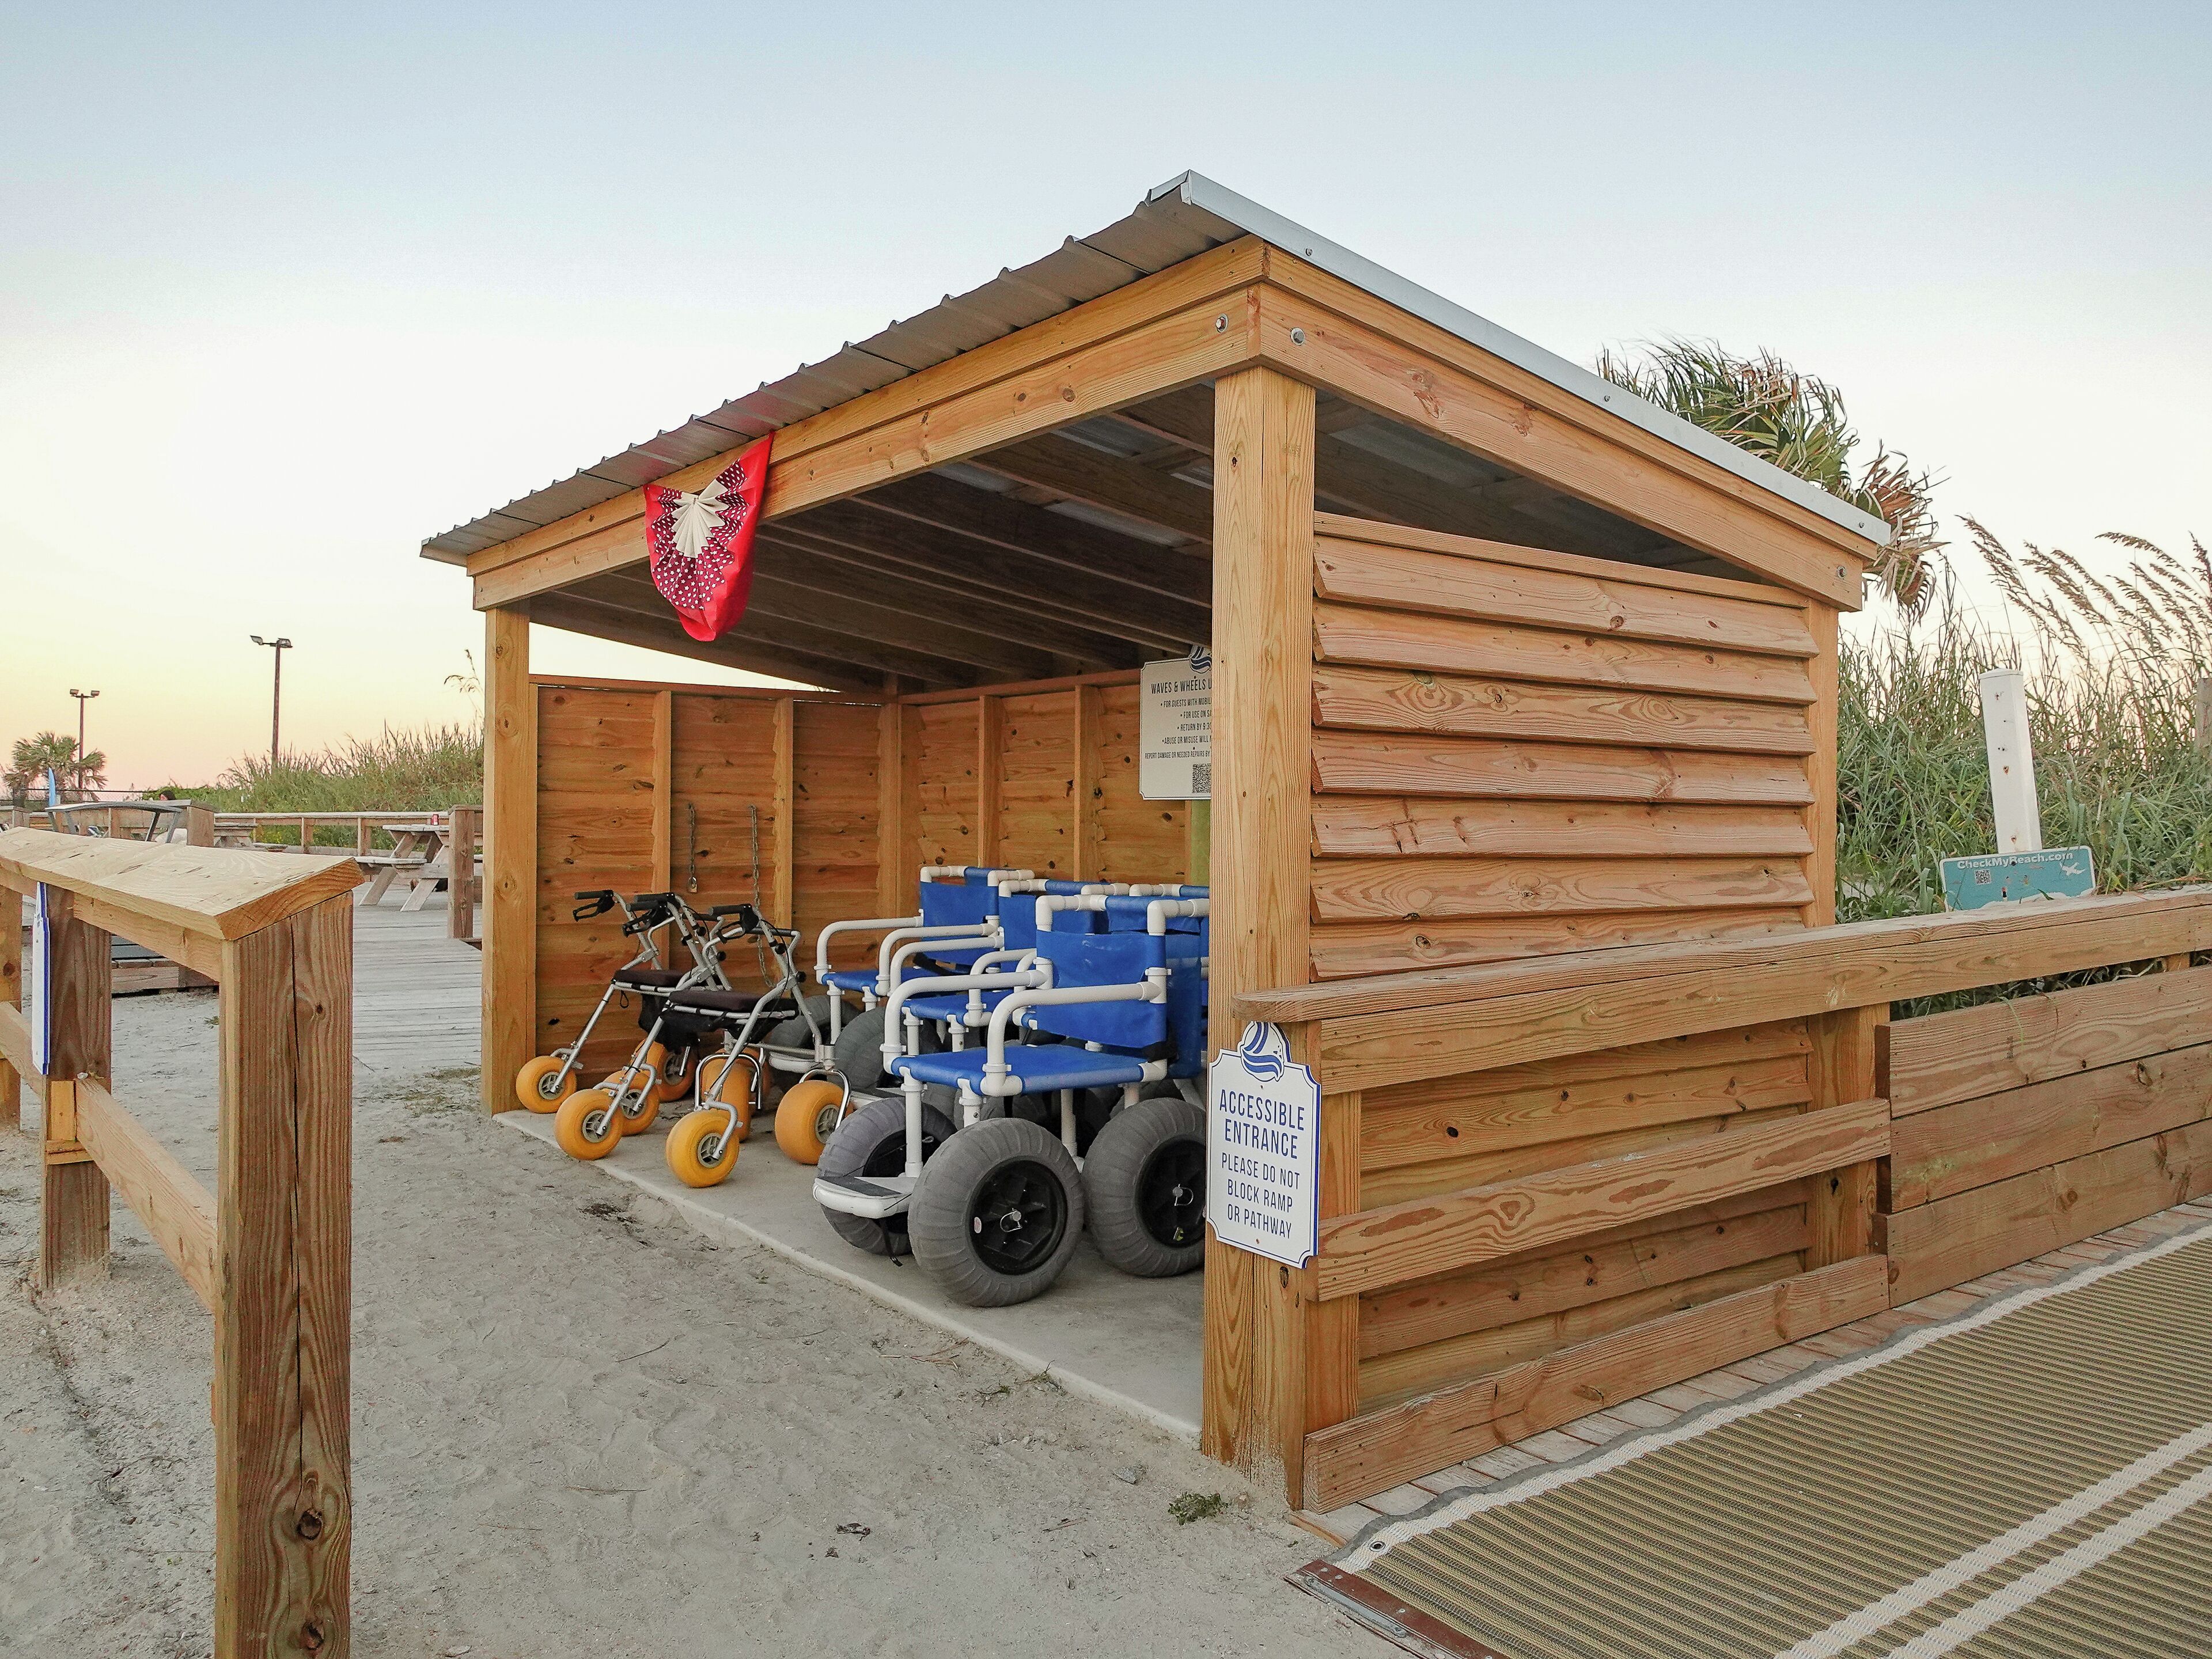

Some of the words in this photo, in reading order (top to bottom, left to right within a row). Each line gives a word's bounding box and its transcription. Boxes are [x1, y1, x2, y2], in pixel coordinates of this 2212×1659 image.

[1152, 682, 1172, 694] WAVES
[1174, 681, 1178, 692] &
[1180, 679, 1206, 692] WHEELS
[1172, 699, 1187, 707] GUESTS
[1187, 698, 1197, 706] WITH
[1200, 710, 1206, 718] ON
[1180, 724, 1196, 732] RETURN
[1196, 723, 1202, 731] BY
[1164, 736, 1176, 744] ABUSE
[1184, 736, 1198, 744] MISUSE
[1199, 735, 1209, 743] WILL
[1957, 852, 2073, 869] CheckMyBeach.com
[1219, 1089, 1304, 1131] ACCESSIBLE
[1225, 1119, 1297, 1159] ENTRANCE
[1222, 1152, 1258, 1179] PLEASE
[1263, 1164, 1275, 1183] DO
[1280, 1168, 1300, 1190] NOT
[1228, 1179, 1259, 1204] BLOCK
[1264, 1189, 1293, 1213] RAMP
[1228, 1204, 1240, 1222] OR
[1244, 1209, 1291, 1239] PATHWAY
